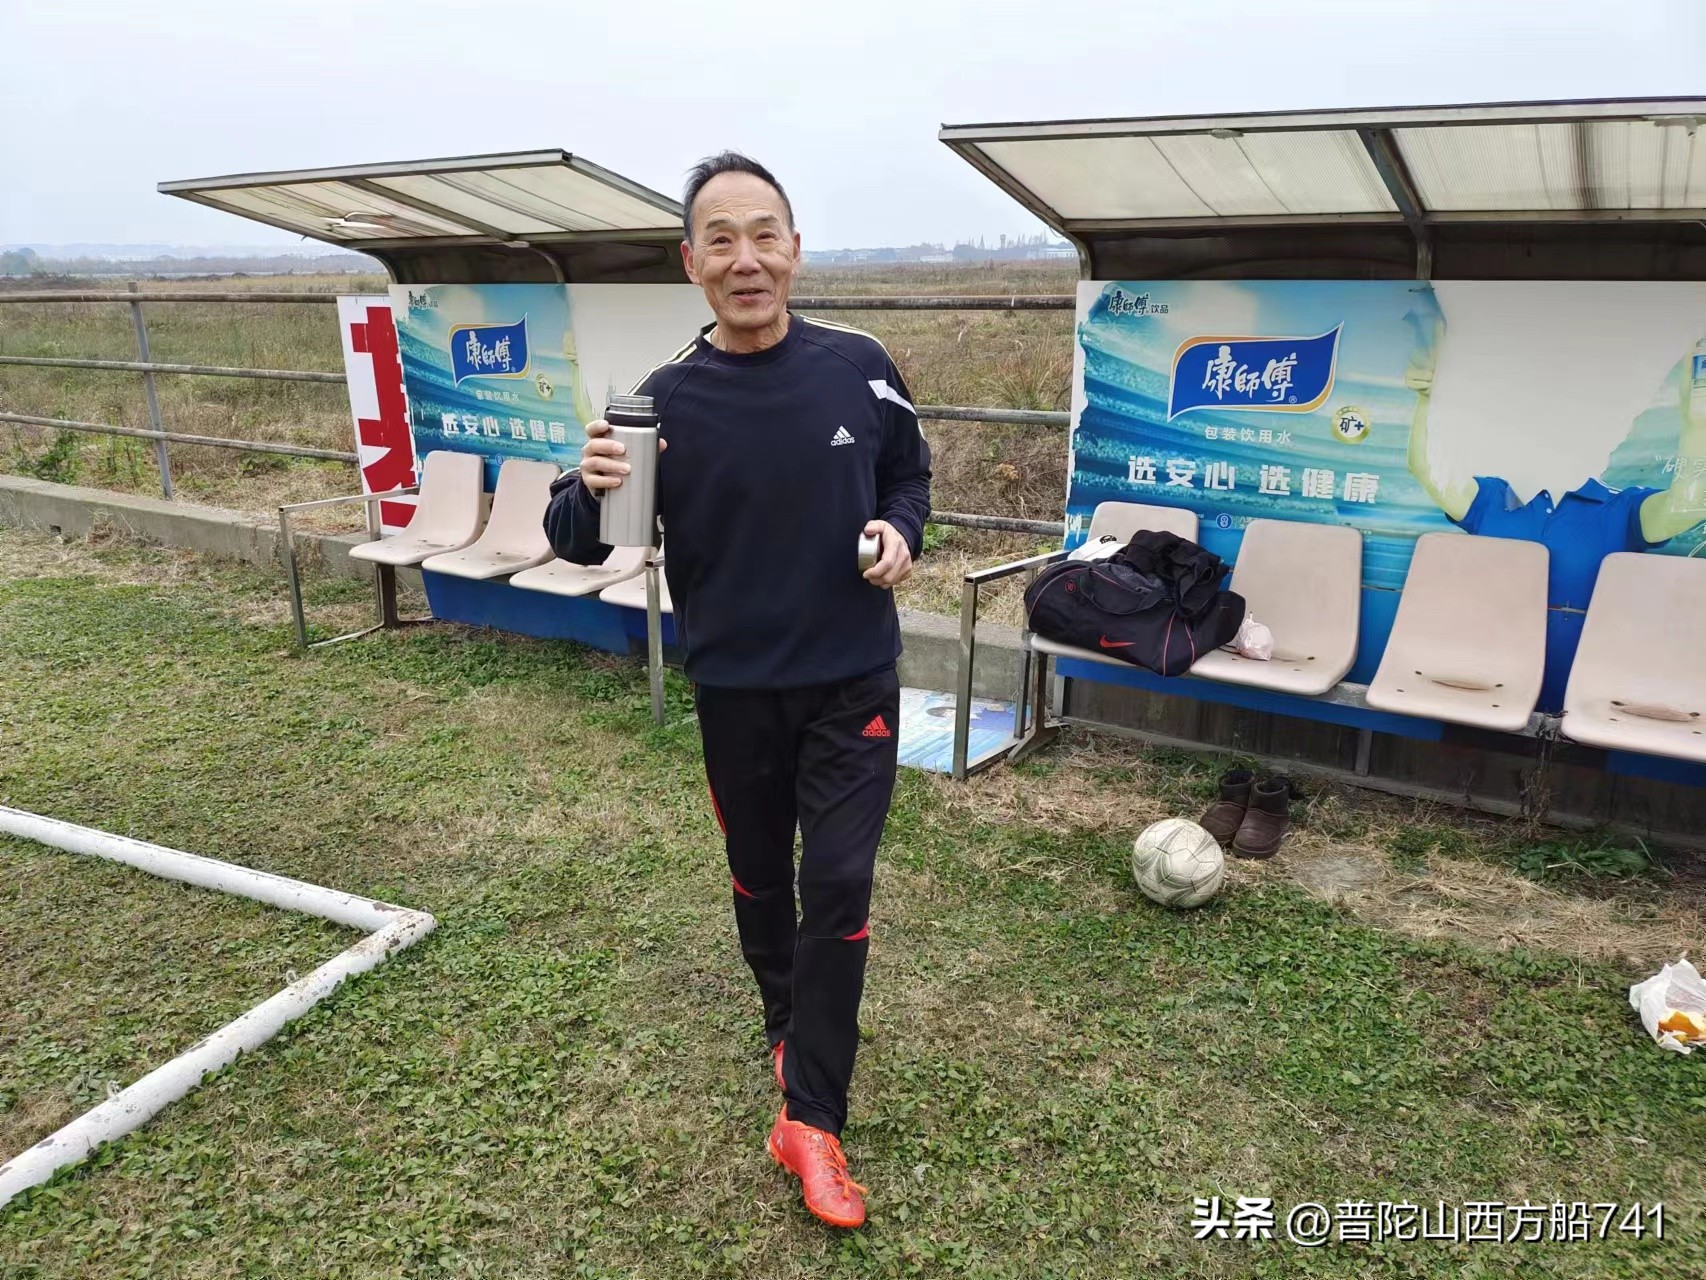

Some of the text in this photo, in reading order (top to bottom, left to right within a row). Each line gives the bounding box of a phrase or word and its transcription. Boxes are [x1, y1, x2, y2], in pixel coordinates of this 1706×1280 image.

[1151, 304, 1169, 314] 饮品
[1339, 416, 1365, 433] 矿+
[830, 436, 855, 446] adidas
[1204, 425, 1292, 444] 包装饮用水
[1127, 455, 1379, 504] 选安心 选健康
[861, 729, 891, 737] adidas
